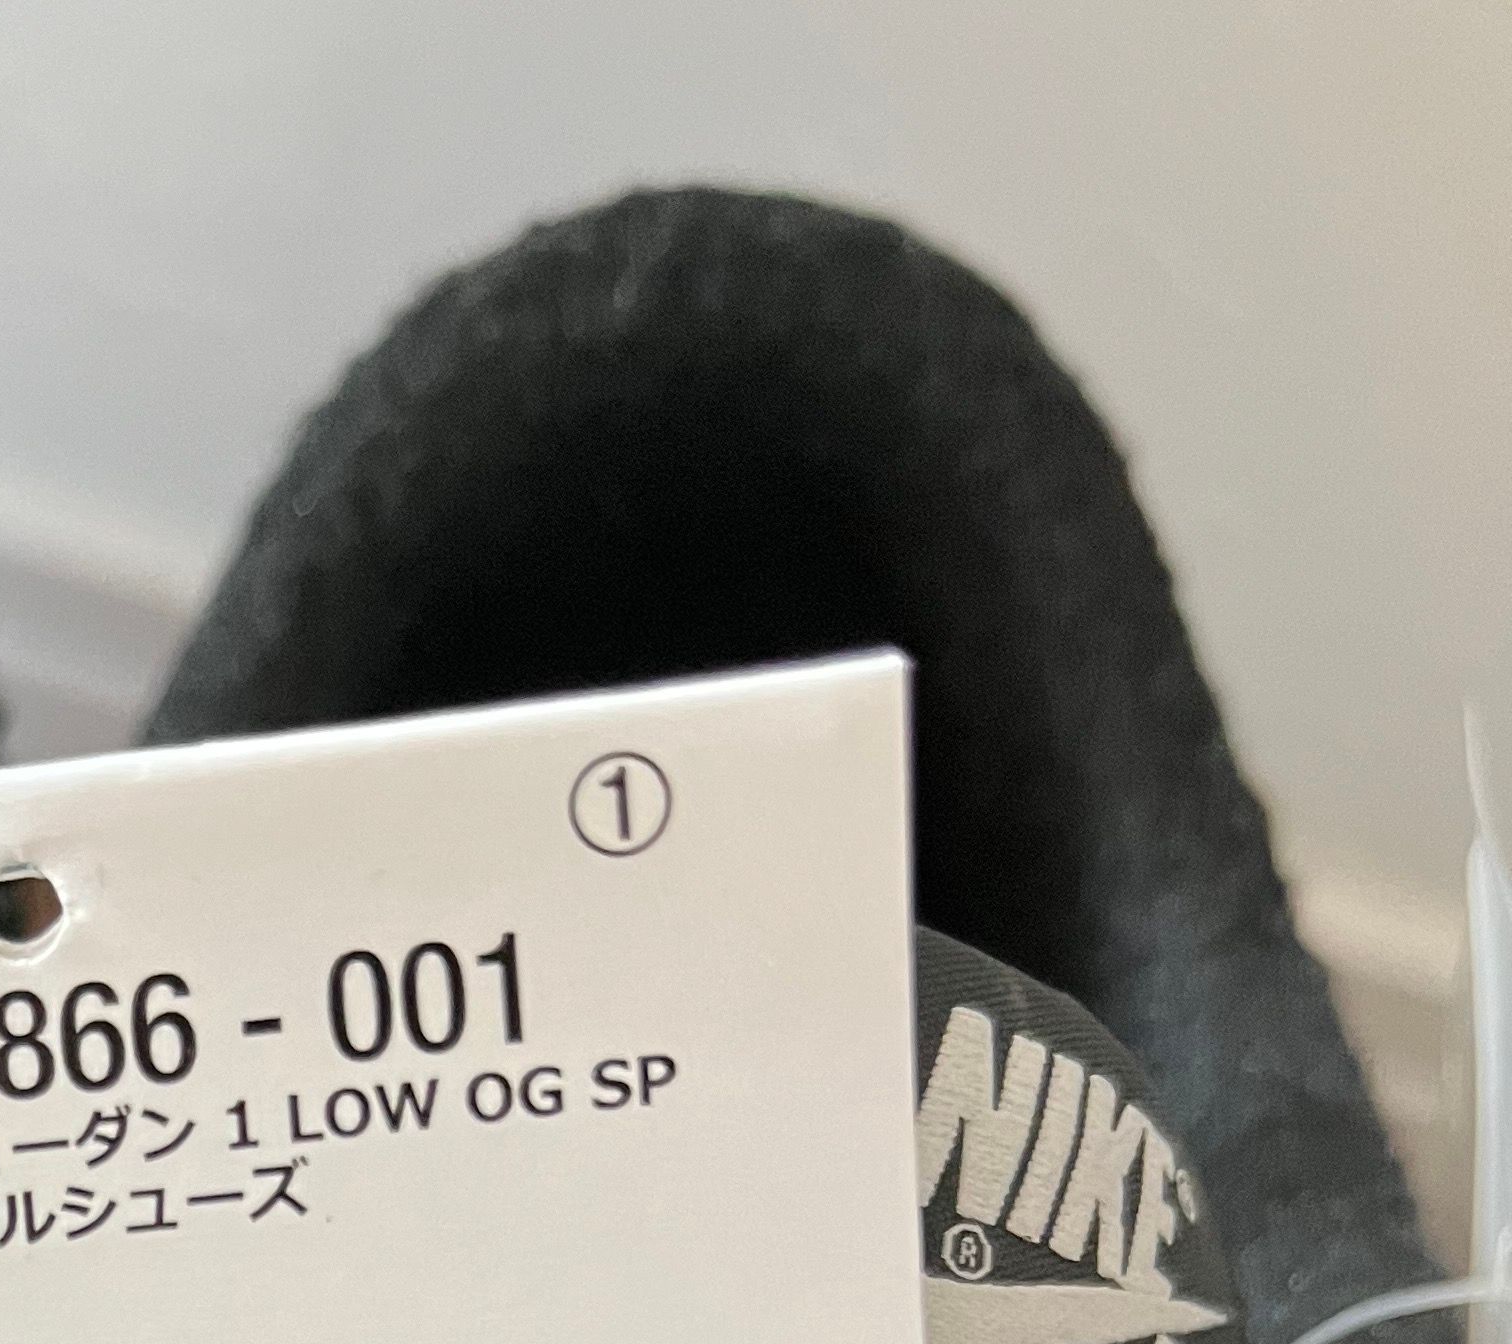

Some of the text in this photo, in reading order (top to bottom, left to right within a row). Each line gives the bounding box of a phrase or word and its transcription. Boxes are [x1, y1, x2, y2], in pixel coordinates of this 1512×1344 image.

[327, 932, 524, 1062] 001
[226, 1099, 260, 1150] 1
[288, 1078, 439, 1143] LOW
[466, 1065, 564, 1123] OG
[591, 1054, 677, 1110] SP
